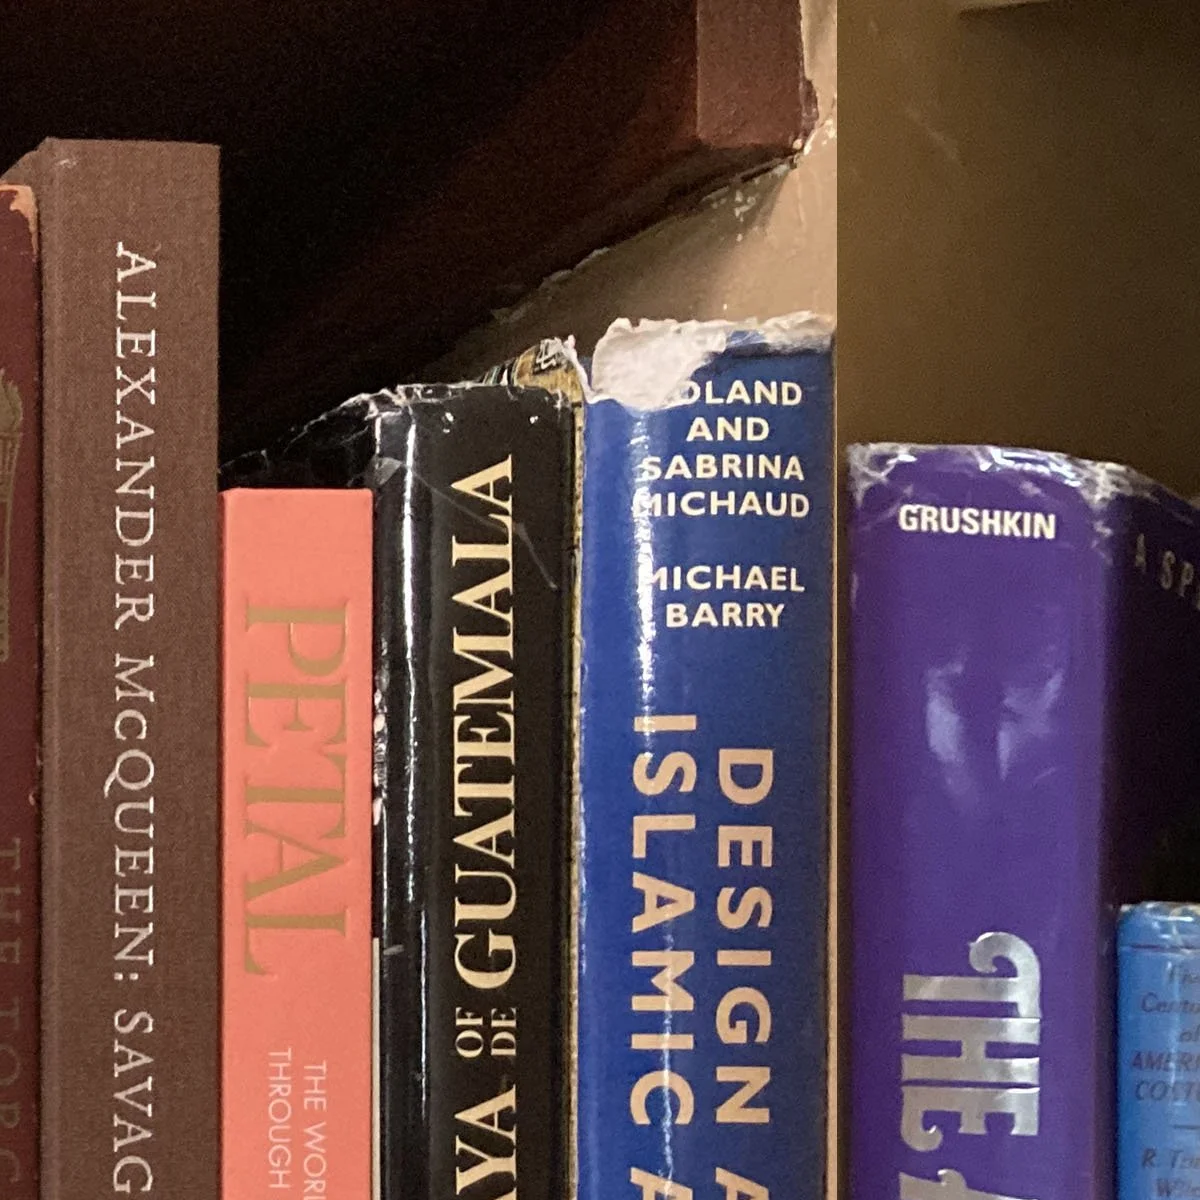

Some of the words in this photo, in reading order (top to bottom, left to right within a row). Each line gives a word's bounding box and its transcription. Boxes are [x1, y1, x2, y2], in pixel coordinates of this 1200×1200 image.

[114, 241, 156, 630] ALEXANDER
[687, 417, 770, 442] AND
[642, 454, 804, 481] SABRINA
[634, 491, 809, 518] MICHAUD
[899, 504, 1055, 539] GRUSHKIN
[643, 566, 805, 592] MICHAEL
[666, 603, 785, 628] BARRY
[451, 454, 518, 990] GUATEMALA
[243, 600, 351, 978] PETAL
[629, 714, 697, 1125] ISLAMIC
[715, 747, 774, 1124] DESIGN
[455, 1007, 484, 1058] OF
[491, 1007, 518, 1057] DE
[900, 932, 1042, 1151] THE
[304, 1060, 327, 1110] THE
[269, 1048, 292, 1188] THROUGH
